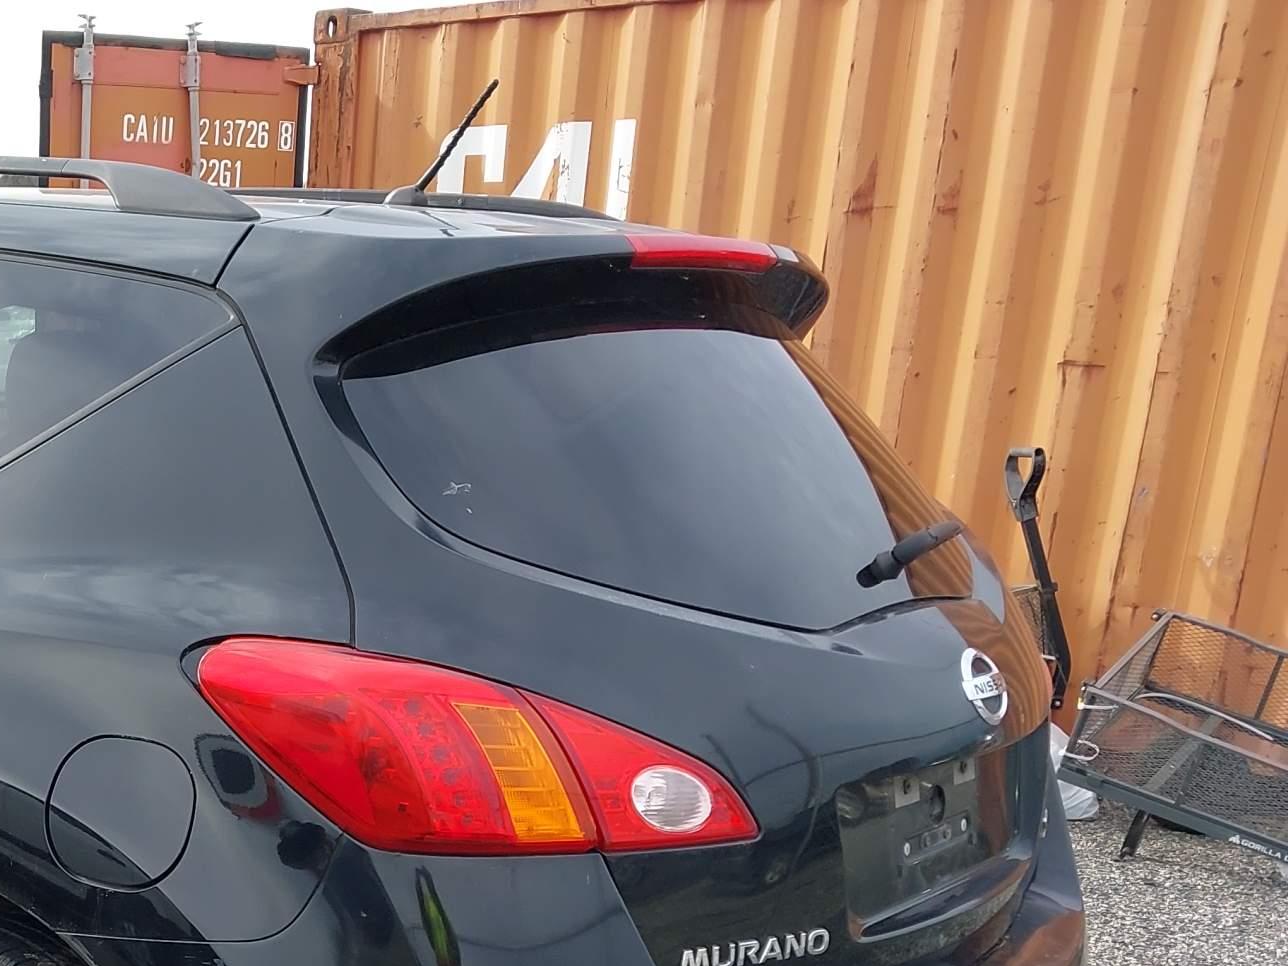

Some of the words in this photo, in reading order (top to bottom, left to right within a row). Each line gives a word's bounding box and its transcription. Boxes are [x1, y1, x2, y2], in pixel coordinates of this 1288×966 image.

[123, 113, 174, 145] CAIU
[200, 118, 269, 149] 213726
[278, 121, 295, 151] 8
